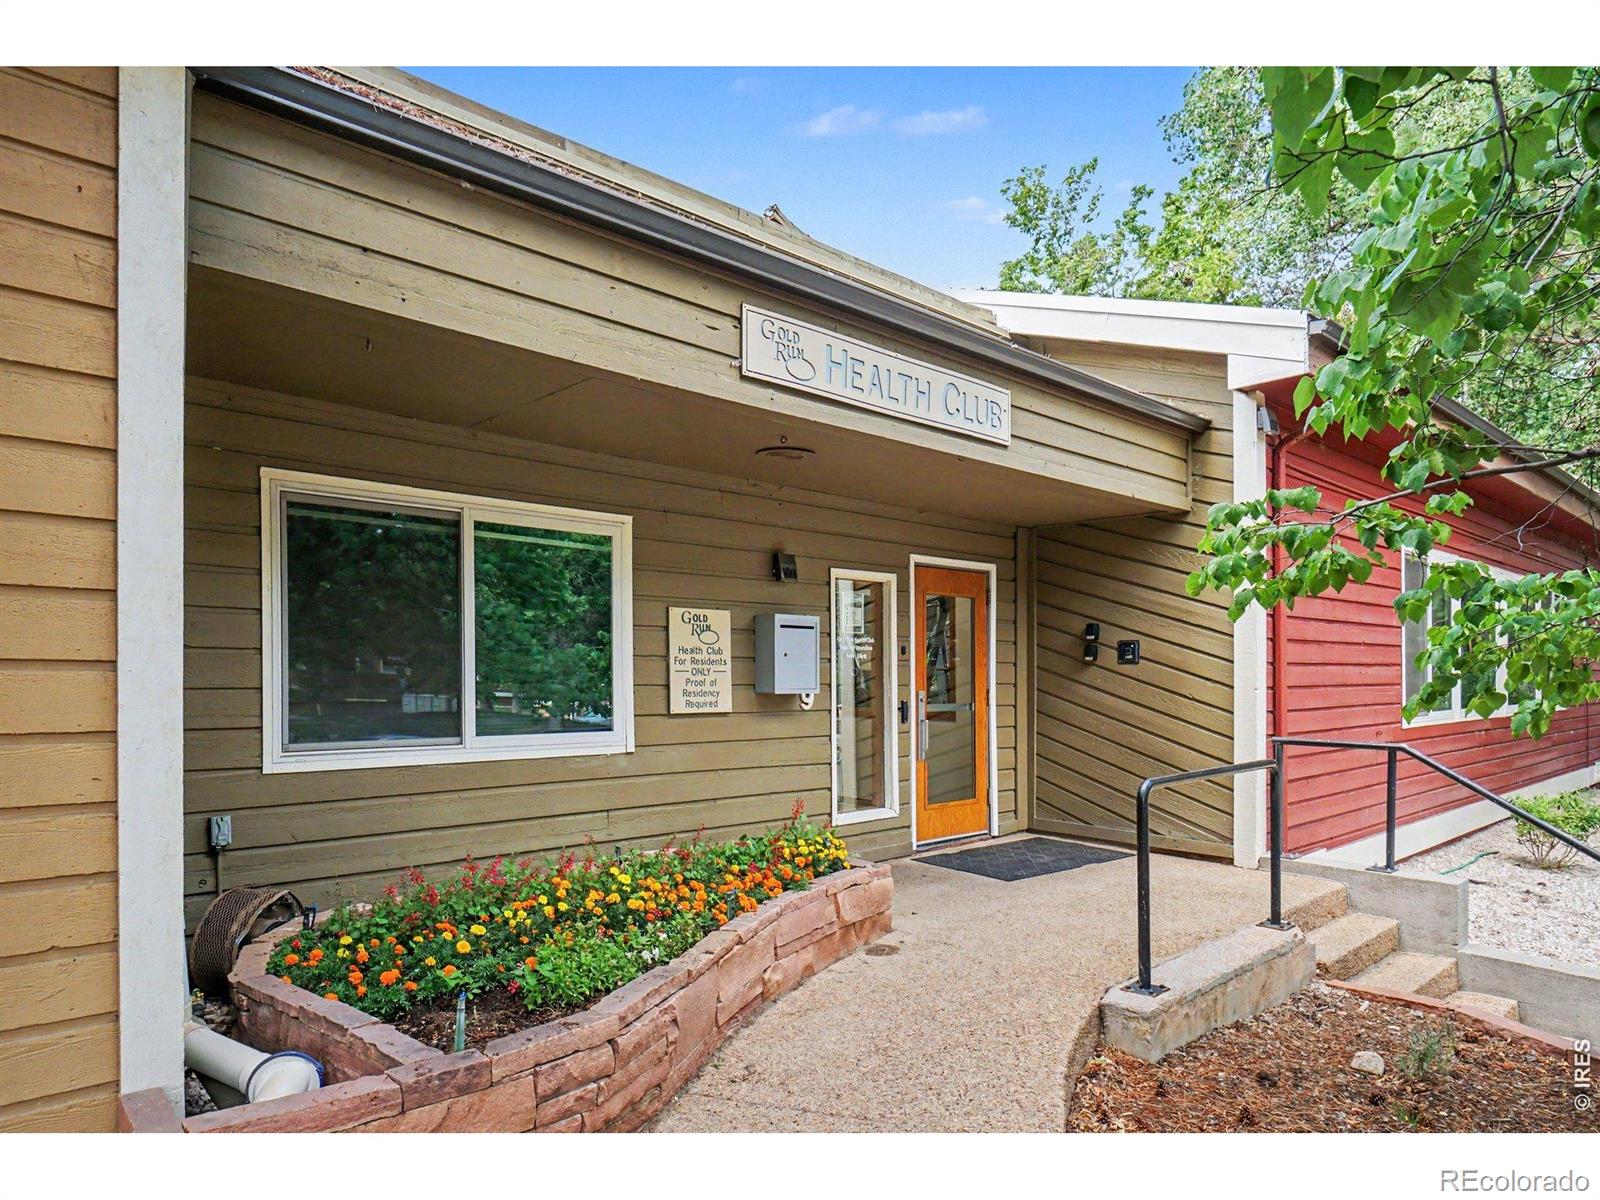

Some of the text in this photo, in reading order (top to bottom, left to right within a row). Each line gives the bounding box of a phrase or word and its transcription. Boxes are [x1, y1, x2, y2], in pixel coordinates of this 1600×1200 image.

[760, 318, 801, 344] GOLD
[774, 341, 811, 373] RUN
[825, 343, 1002, 430] HEALTH CLUB
[681, 610, 708, 624] GOLD
[691, 623, 715, 640] RUN
[678, 646, 724, 655] Health Club
[674, 657, 728, 666] For Residents
[691, 668, 712, 677] ONLY
[685, 678, 717, 687] Proof of
[682, 689, 720, 699] Residency
[685, 699, 719, 709] Required
